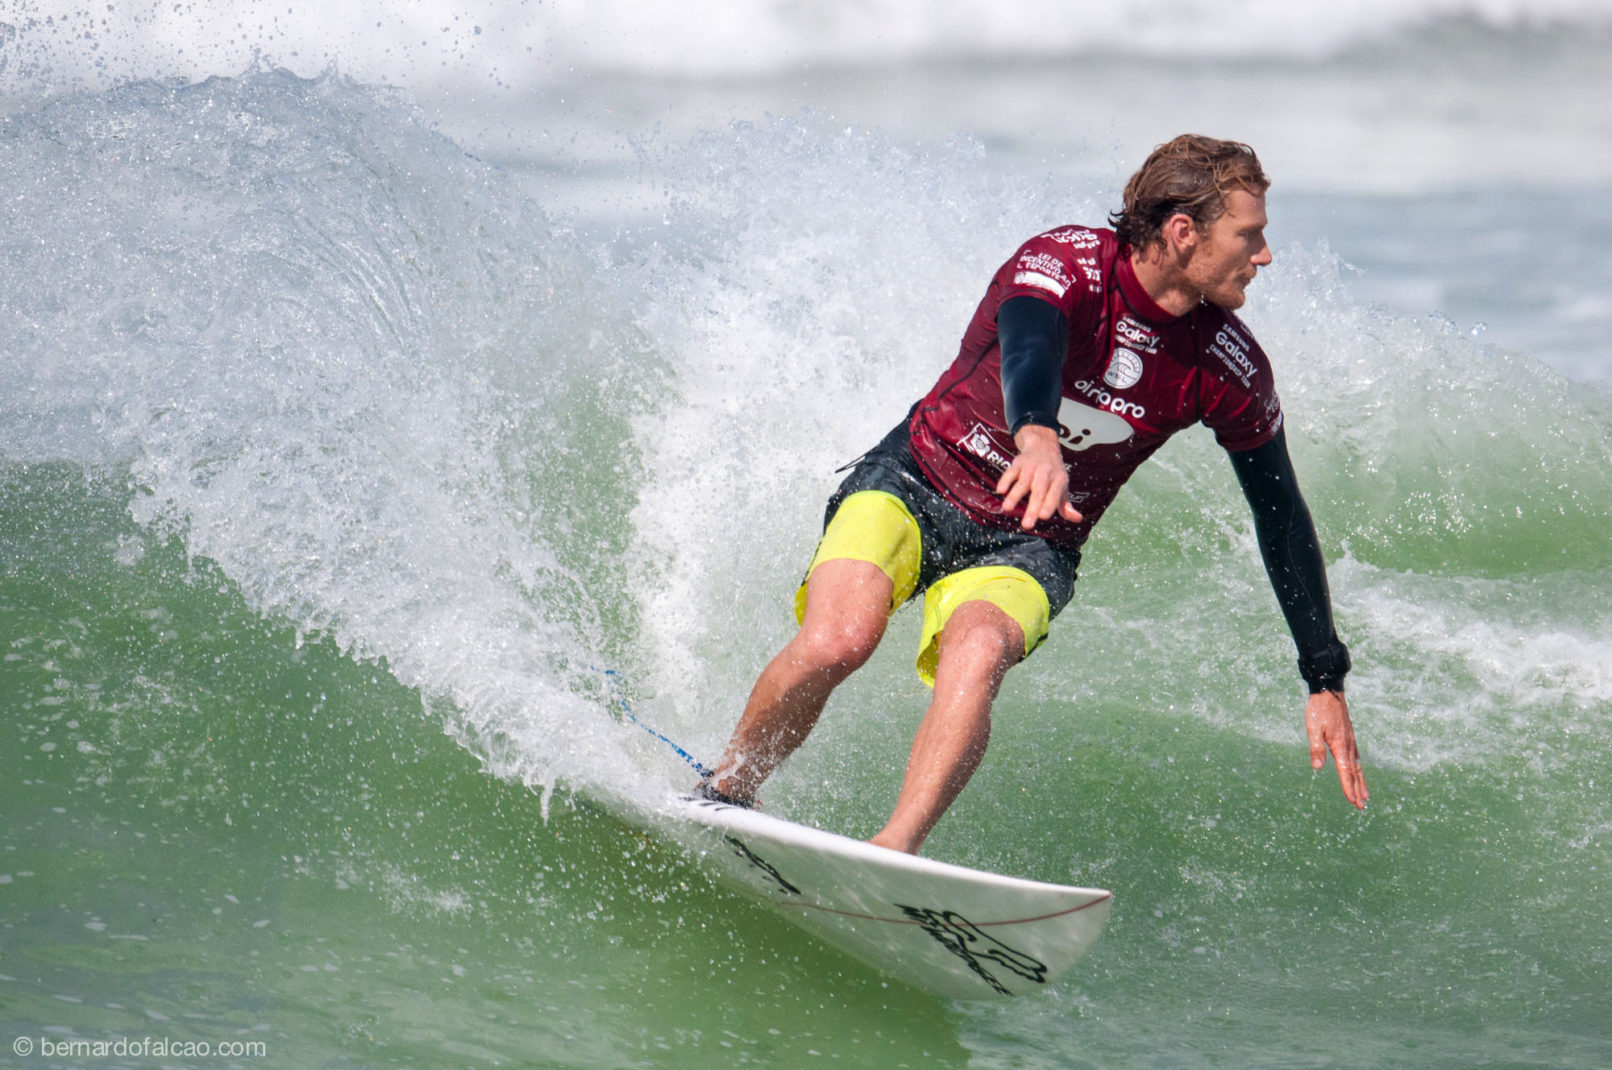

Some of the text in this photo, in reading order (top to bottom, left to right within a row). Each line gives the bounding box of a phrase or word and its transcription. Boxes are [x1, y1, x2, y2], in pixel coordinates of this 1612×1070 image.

[1020, 255, 1062, 276] INCENTIVO
[1038, 252, 1064, 267] LEI DE
[1025, 263, 1060, 280] ESPORTE
[1222, 323, 1250, 351] SAMSUNG
[1216, 331, 1258, 377] Galaxy
